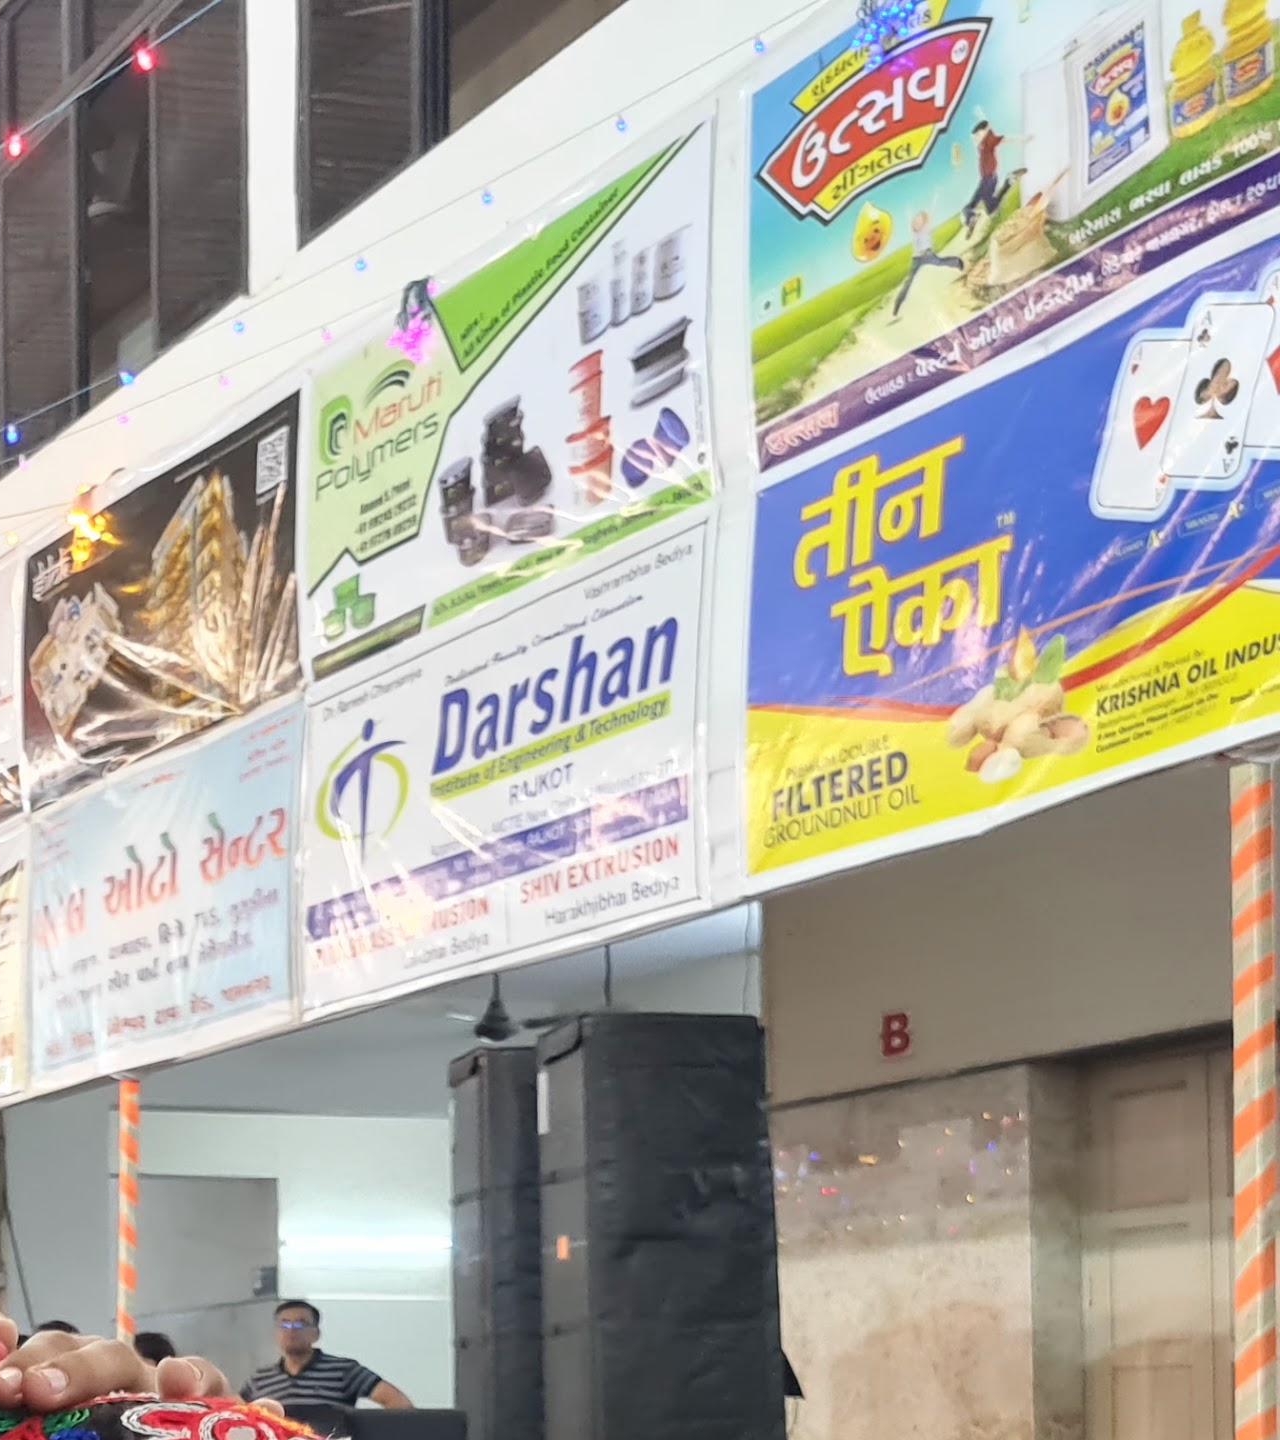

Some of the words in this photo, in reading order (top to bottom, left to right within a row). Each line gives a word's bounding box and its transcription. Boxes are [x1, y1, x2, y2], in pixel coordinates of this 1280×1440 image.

[791, 64, 948, 189] ઉત્સવ
[353, 371, 444, 445] Maruti
[314, 411, 440, 503] Polymers
[793, 435, 966, 591] तीन
[431, 615, 679, 777] Darshan
[1096, 672, 1181, 718] KRISHNA
[1187, 657, 1218, 684] OIL
[498, 733, 573, 776] Engineering
[588, 696, 669, 737] Technology
[762, 793, 883, 849] GROUNDNUT
[887, 783, 922, 812] OIL
[771, 750, 909, 823] FILTERED
[102, 831, 180, 916] ઓટો
[199, 807, 289, 884] સેન્ટર
[519, 870, 563, 905] SHIV
[567, 834, 682, 890] EXTRUSION
[881, 1012, 911, 1056] B
